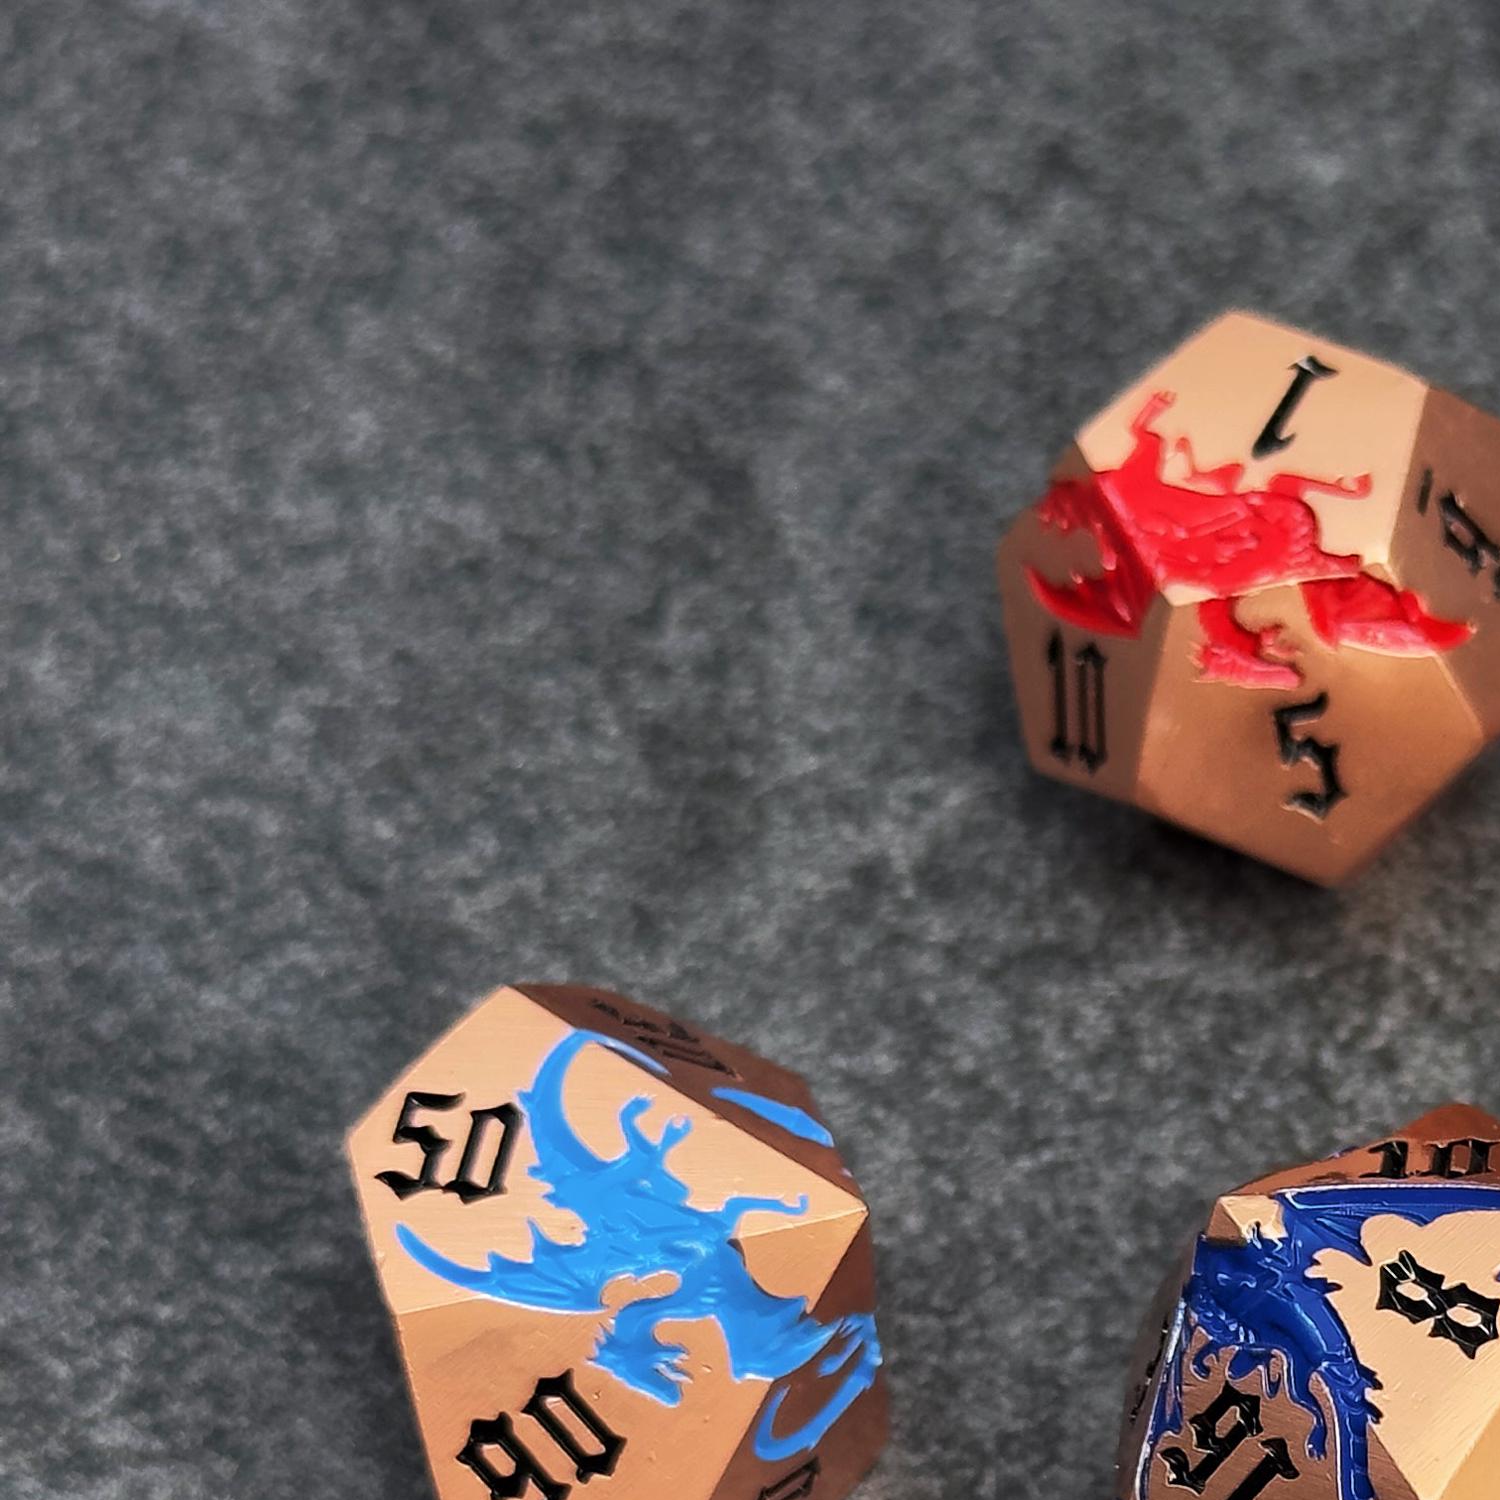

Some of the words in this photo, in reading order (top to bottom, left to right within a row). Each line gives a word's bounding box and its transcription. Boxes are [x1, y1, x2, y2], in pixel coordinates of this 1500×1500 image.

[1252, 355, 1340, 457] 1
[1272, 690, 1348, 824] 5
[374, 1092, 525, 1205] 50
[1377, 1250, 1500, 1360] 8
